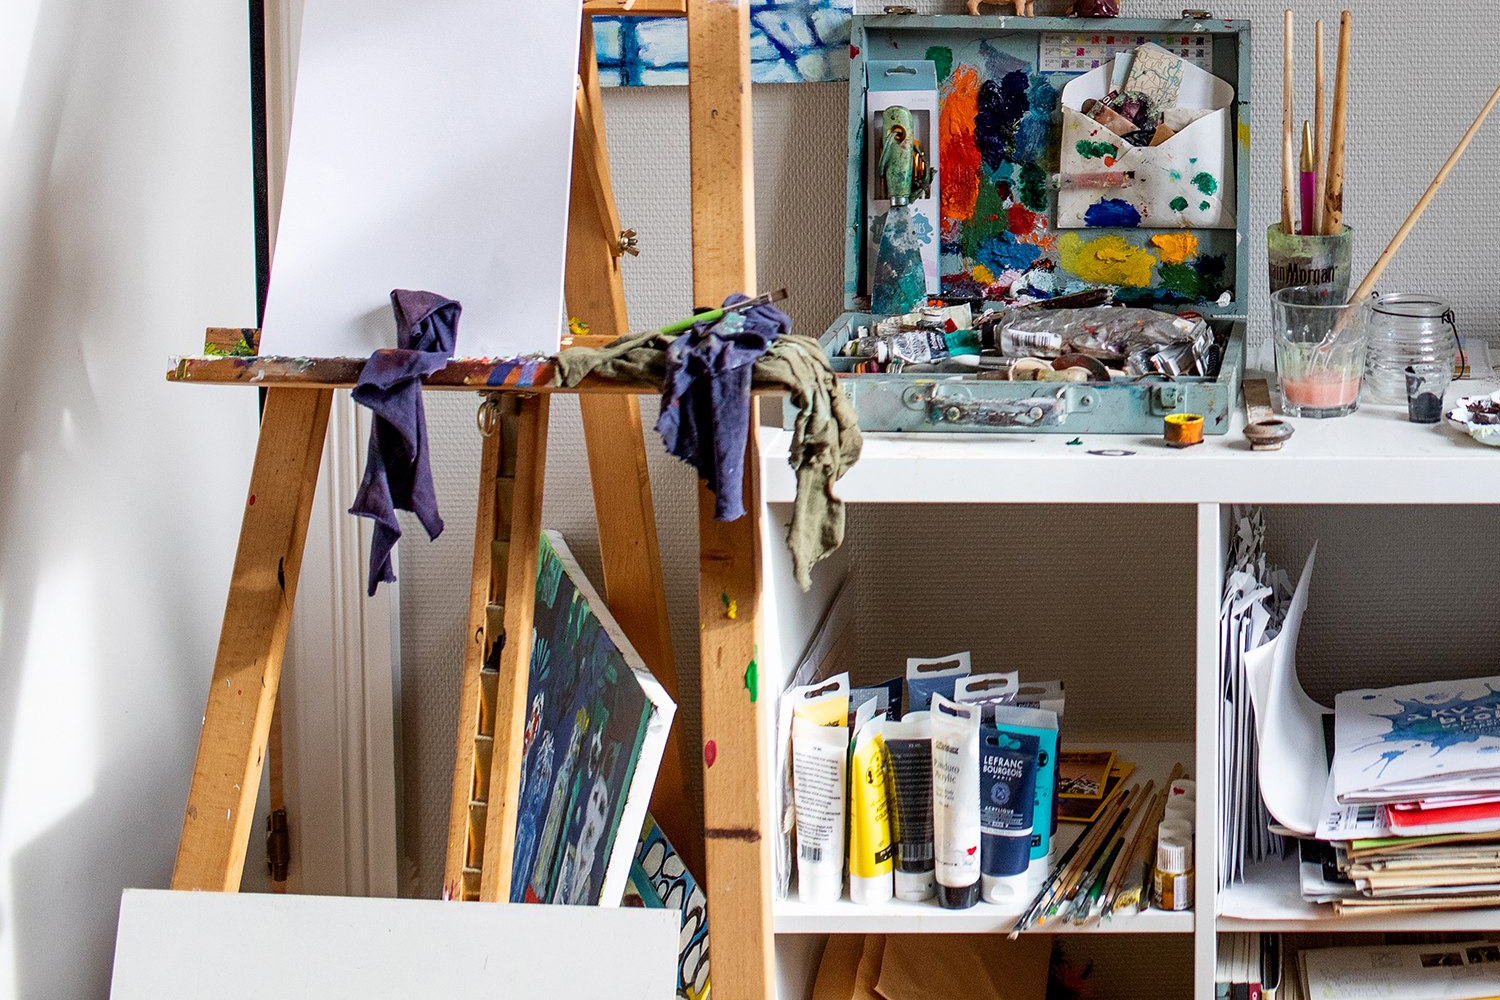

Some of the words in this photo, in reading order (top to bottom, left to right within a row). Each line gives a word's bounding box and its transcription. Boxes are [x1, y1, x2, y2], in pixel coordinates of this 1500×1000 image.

[1286, 262, 1335, 285] Morgan
[983, 755, 1024, 769] LEFRANC
[982, 765, 1024, 778] BOURGEOIS
[984, 805, 1014, 815] ACRYLIQUE
